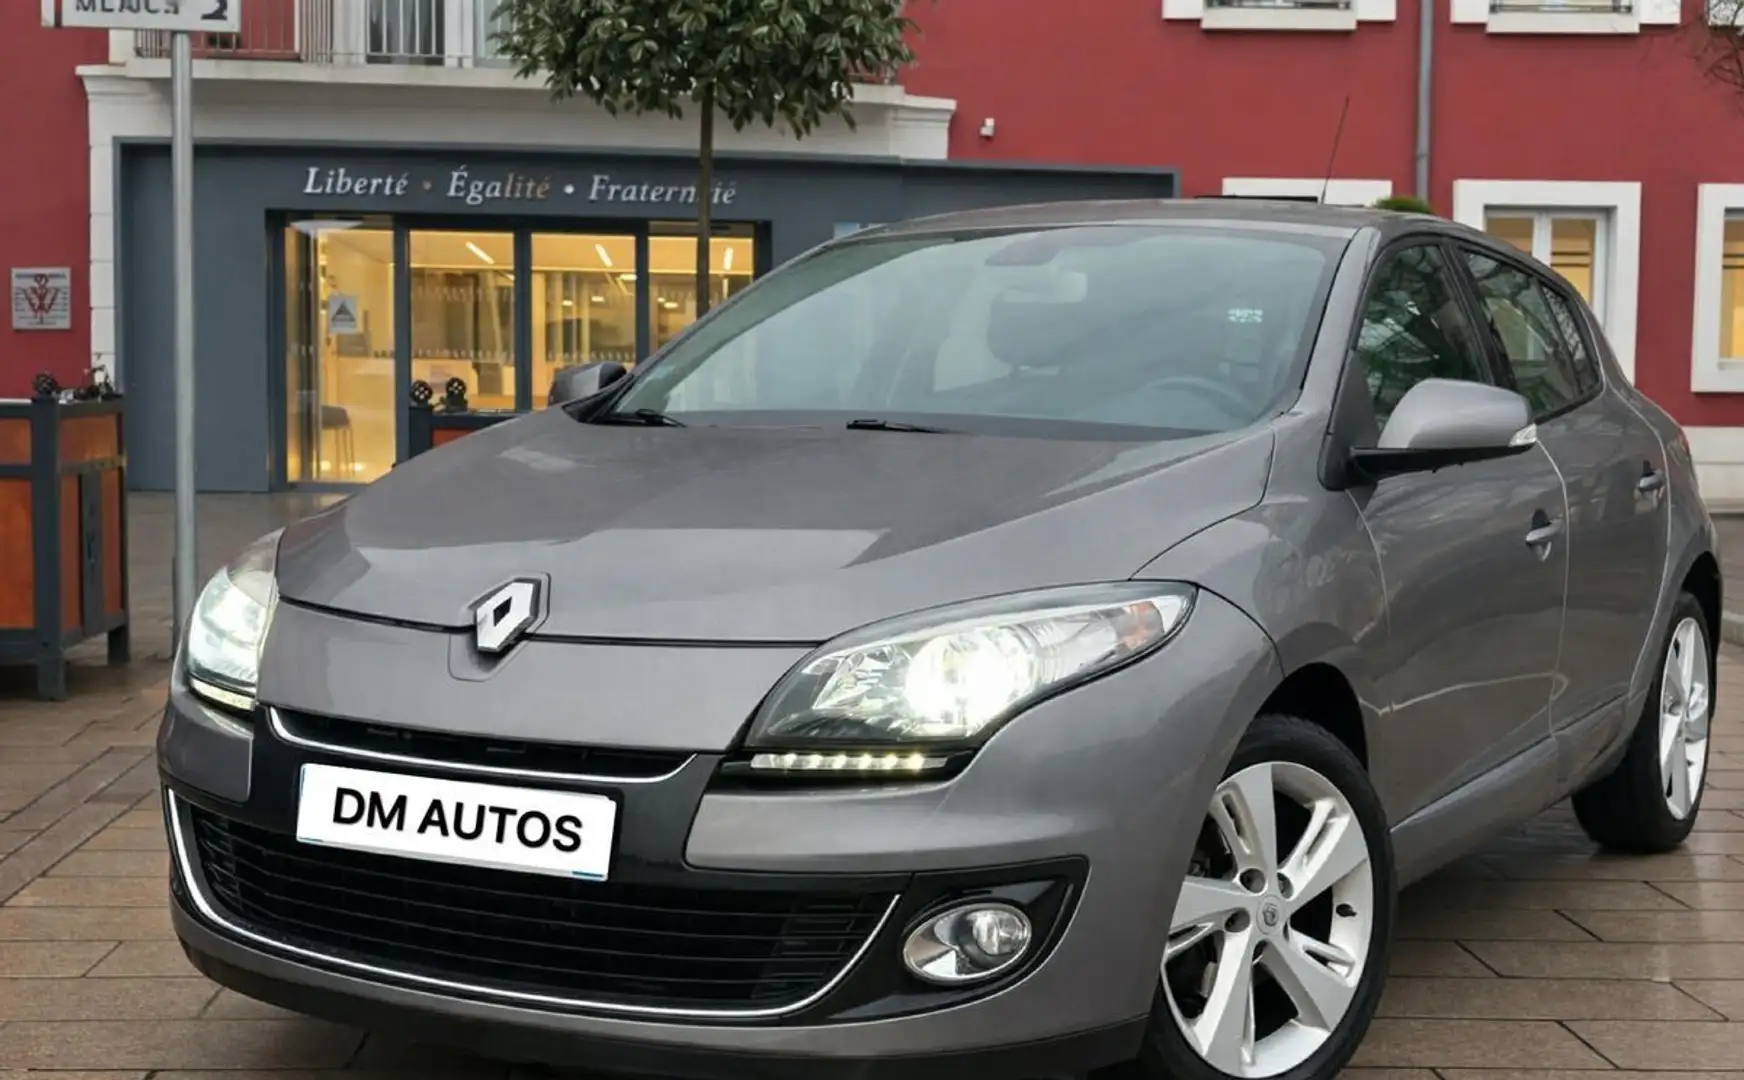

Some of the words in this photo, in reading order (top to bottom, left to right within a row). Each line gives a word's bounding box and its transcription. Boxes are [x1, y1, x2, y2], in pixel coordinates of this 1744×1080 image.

[303, 166, 410, 196] Liberté
[446, 164, 551, 205] Égalité
[332, 786, 408, 832] DM
[416, 798, 583, 853] AUTOS
